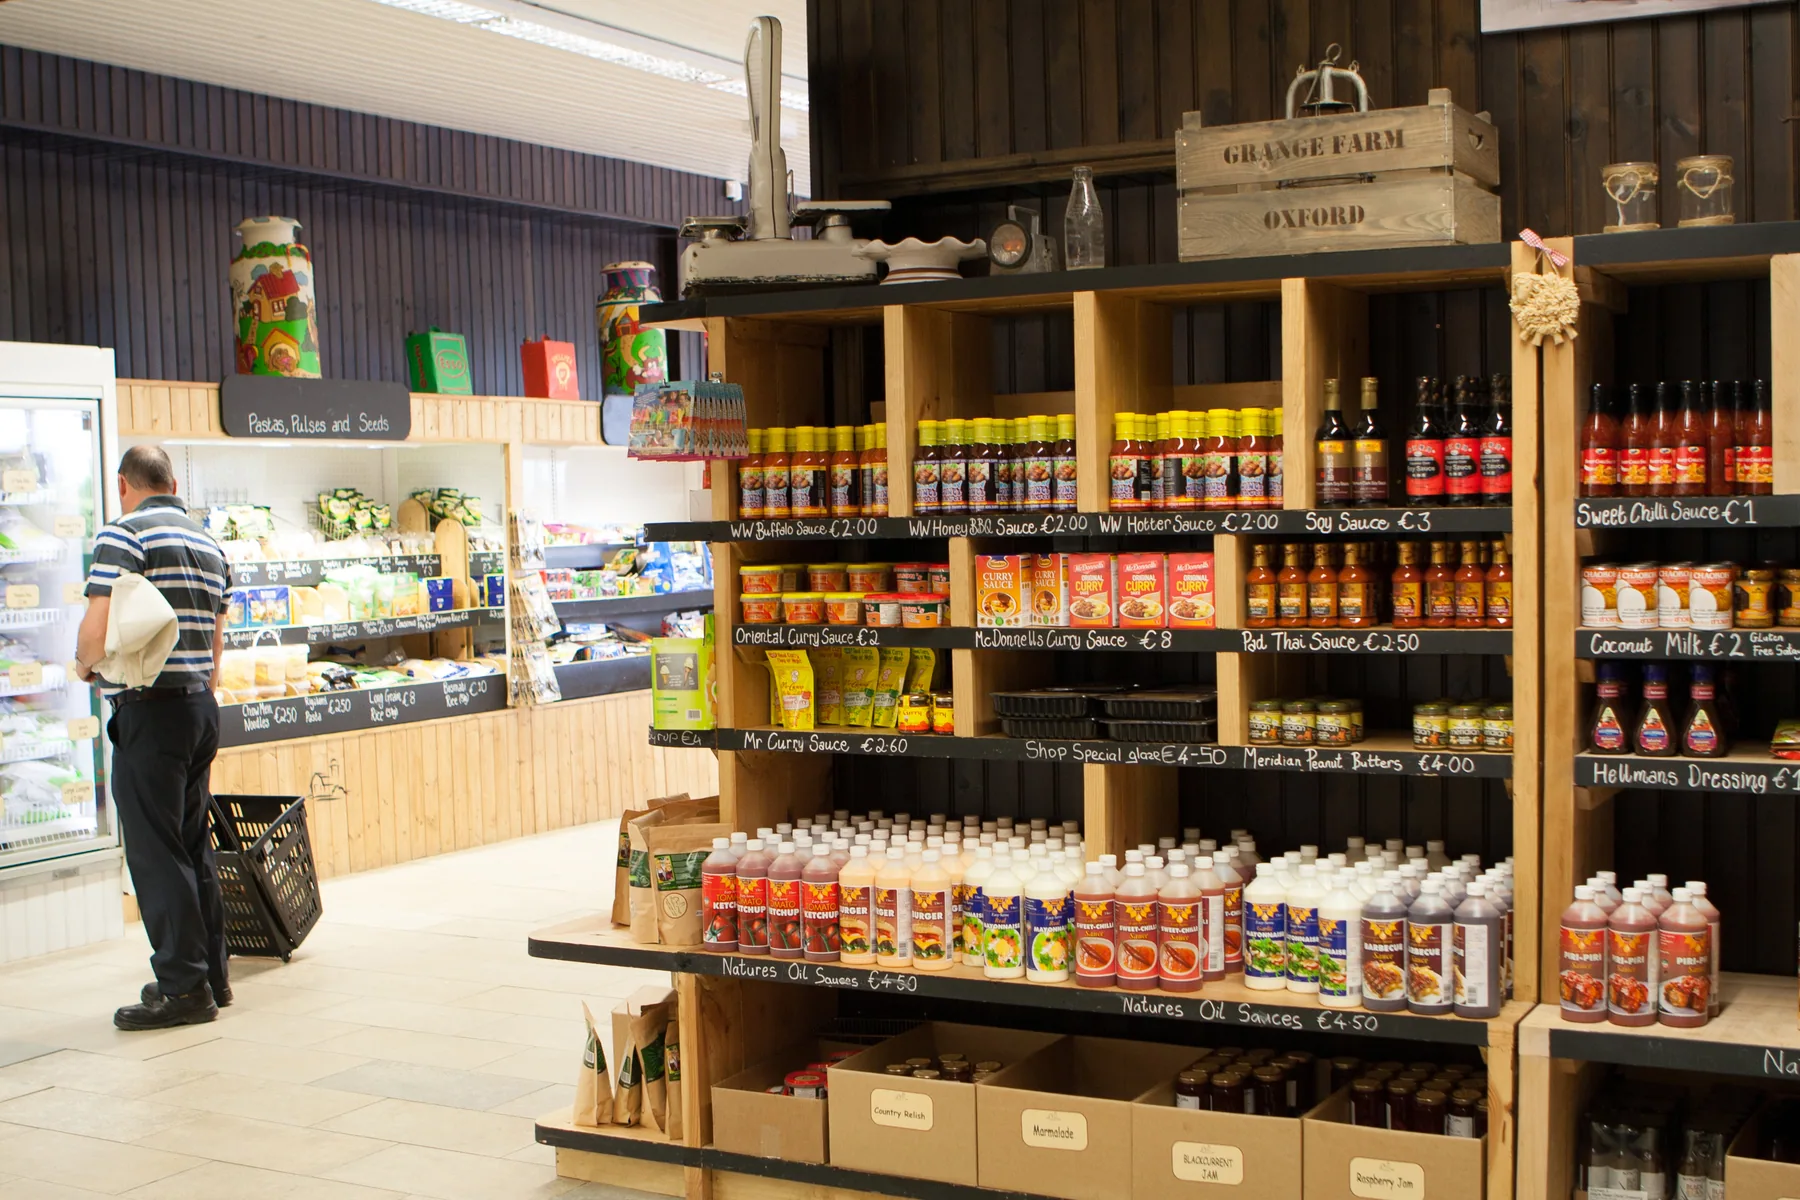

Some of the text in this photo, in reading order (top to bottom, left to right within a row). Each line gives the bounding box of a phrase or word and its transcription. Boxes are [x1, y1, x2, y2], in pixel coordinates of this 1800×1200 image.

[1223, 129, 1404, 164] GRANGE FARM
[1264, 205, 1365, 229] OXFORD
[292, 413, 326, 433] Pulses
[332, 413, 350, 433] and
[359, 412, 390, 432] Seeds
[1305, 511, 1431, 534] Soy Sauce €3
[1577, 500, 1757, 526] Sweet Chilli Sauce €1
[730, 521, 754, 538] WW
[756, 520, 794, 540] Buffalo
[796, 521, 828, 535] Sauce
[909, 519, 930, 536] WW
[932, 519, 968, 538] Honey
[969, 517, 993, 536] BBQ
[996, 518, 1037, 536] Sauce
[1099, 515, 1122, 533] WW
[1127, 516, 1172, 534] Hotter
[1173, 514, 1216, 533] Sauce
[983, 572, 1014, 581] CURRY
[1035, 570, 1056, 579] CURRY
[1035, 579, 1056, 588] SAUCE
[984, 581, 1014, 589] SAUCE
[1075, 581, 1103, 591] CURRY
[1126, 581, 1156, 591] CURRY
[1176, 581, 1208, 591] CURRY
[736, 627, 785, 645] Oriental
[787, 628, 819, 648] Curry
[821, 628, 855, 645] Sauce
[1046, 629, 1081, 650] Curry
[1086, 629, 1128, 648] Sauce
[1241, 631, 1268, 652] Pad
[1271, 631, 1306, 650] Thai
[1309, 631, 1360, 650] Sauce
[1590, 633, 1653, 655] Coconut
[1665, 632, 1704, 656] Milk
[1753, 645, 1774, 656] Free
[744, 732, 762, 749] Mr
[767, 732, 804, 753] Curry
[808, 734, 850, 752] Sauce
[1026, 740, 1067, 760] Shop
[1073, 743, 1122, 762] Special
[1126, 748, 1162, 764] glaze
[1243, 747, 1302, 769] Meridian
[1304, 748, 1343, 770] Peanut
[1351, 752, 1403, 772] Butters
[1593, 762, 1679, 786] Hellmans
[1688, 764, 1767, 793] Dressing
[804, 910, 839, 919] KETCHUP
[722, 956, 777, 978] Natures
[787, 962, 808, 980] Oil
[815, 967, 859, 988] Sauces
[1122, 996, 1184, 1017] Natures
[1199, 999, 1226, 1020] Oil
[1238, 1003, 1303, 1029] Sauces
[874, 1106, 926, 1121] Country Relish
[1032, 1124, 1073, 1140] Marmalade
[1183, 1154, 1233, 1168] BLACKCURRENT
[1201, 1167, 1218, 1181] JAM
[1356, 1172, 1414, 1191] Raspberry Jam
